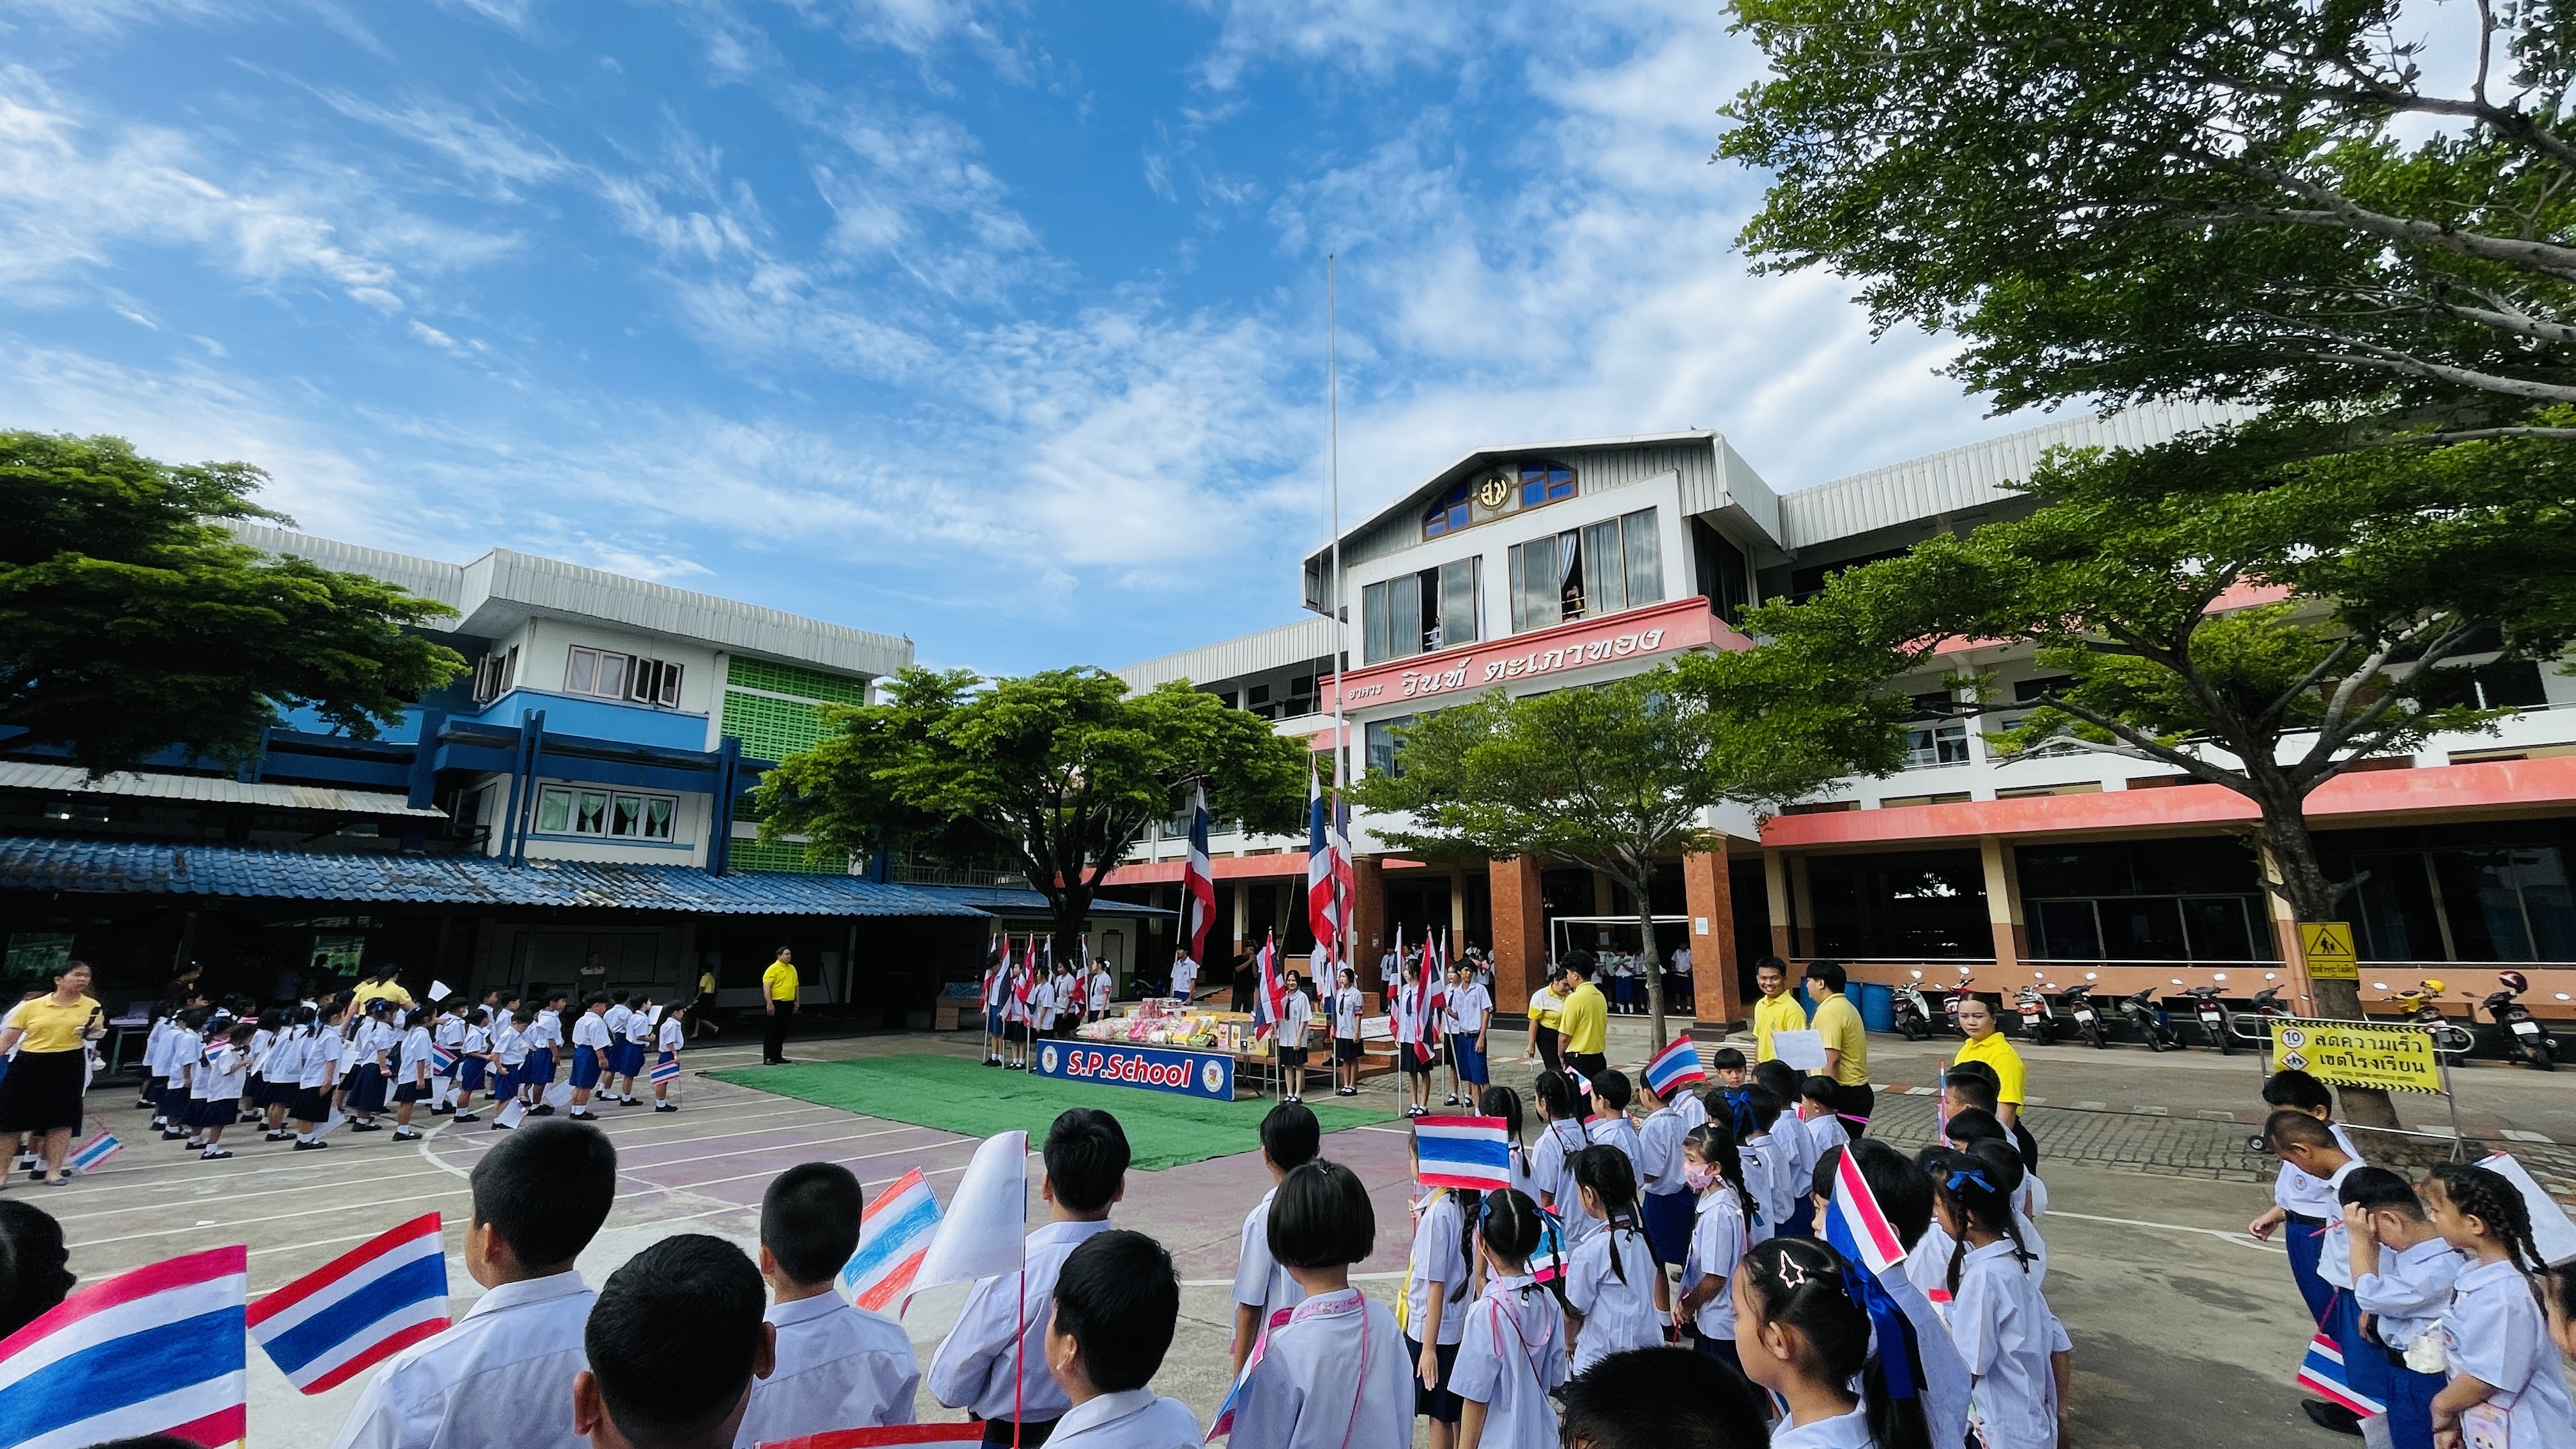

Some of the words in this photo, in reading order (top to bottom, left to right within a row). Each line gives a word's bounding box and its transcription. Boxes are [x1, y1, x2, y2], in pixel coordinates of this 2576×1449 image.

[1348, 683, 1383, 700] อาคาร
[1400, 657, 1472, 696] วินท์
[1483, 629, 1665, 682] ตะเภาทอง
[2285, 1032, 2301, 1043] 10
[2315, 1034, 2423, 1054] ลดความเร็ว
[1067, 1050, 1193, 1089] S.P.School
[2319, 1051, 2427, 1074] เขตโรงเรียน
